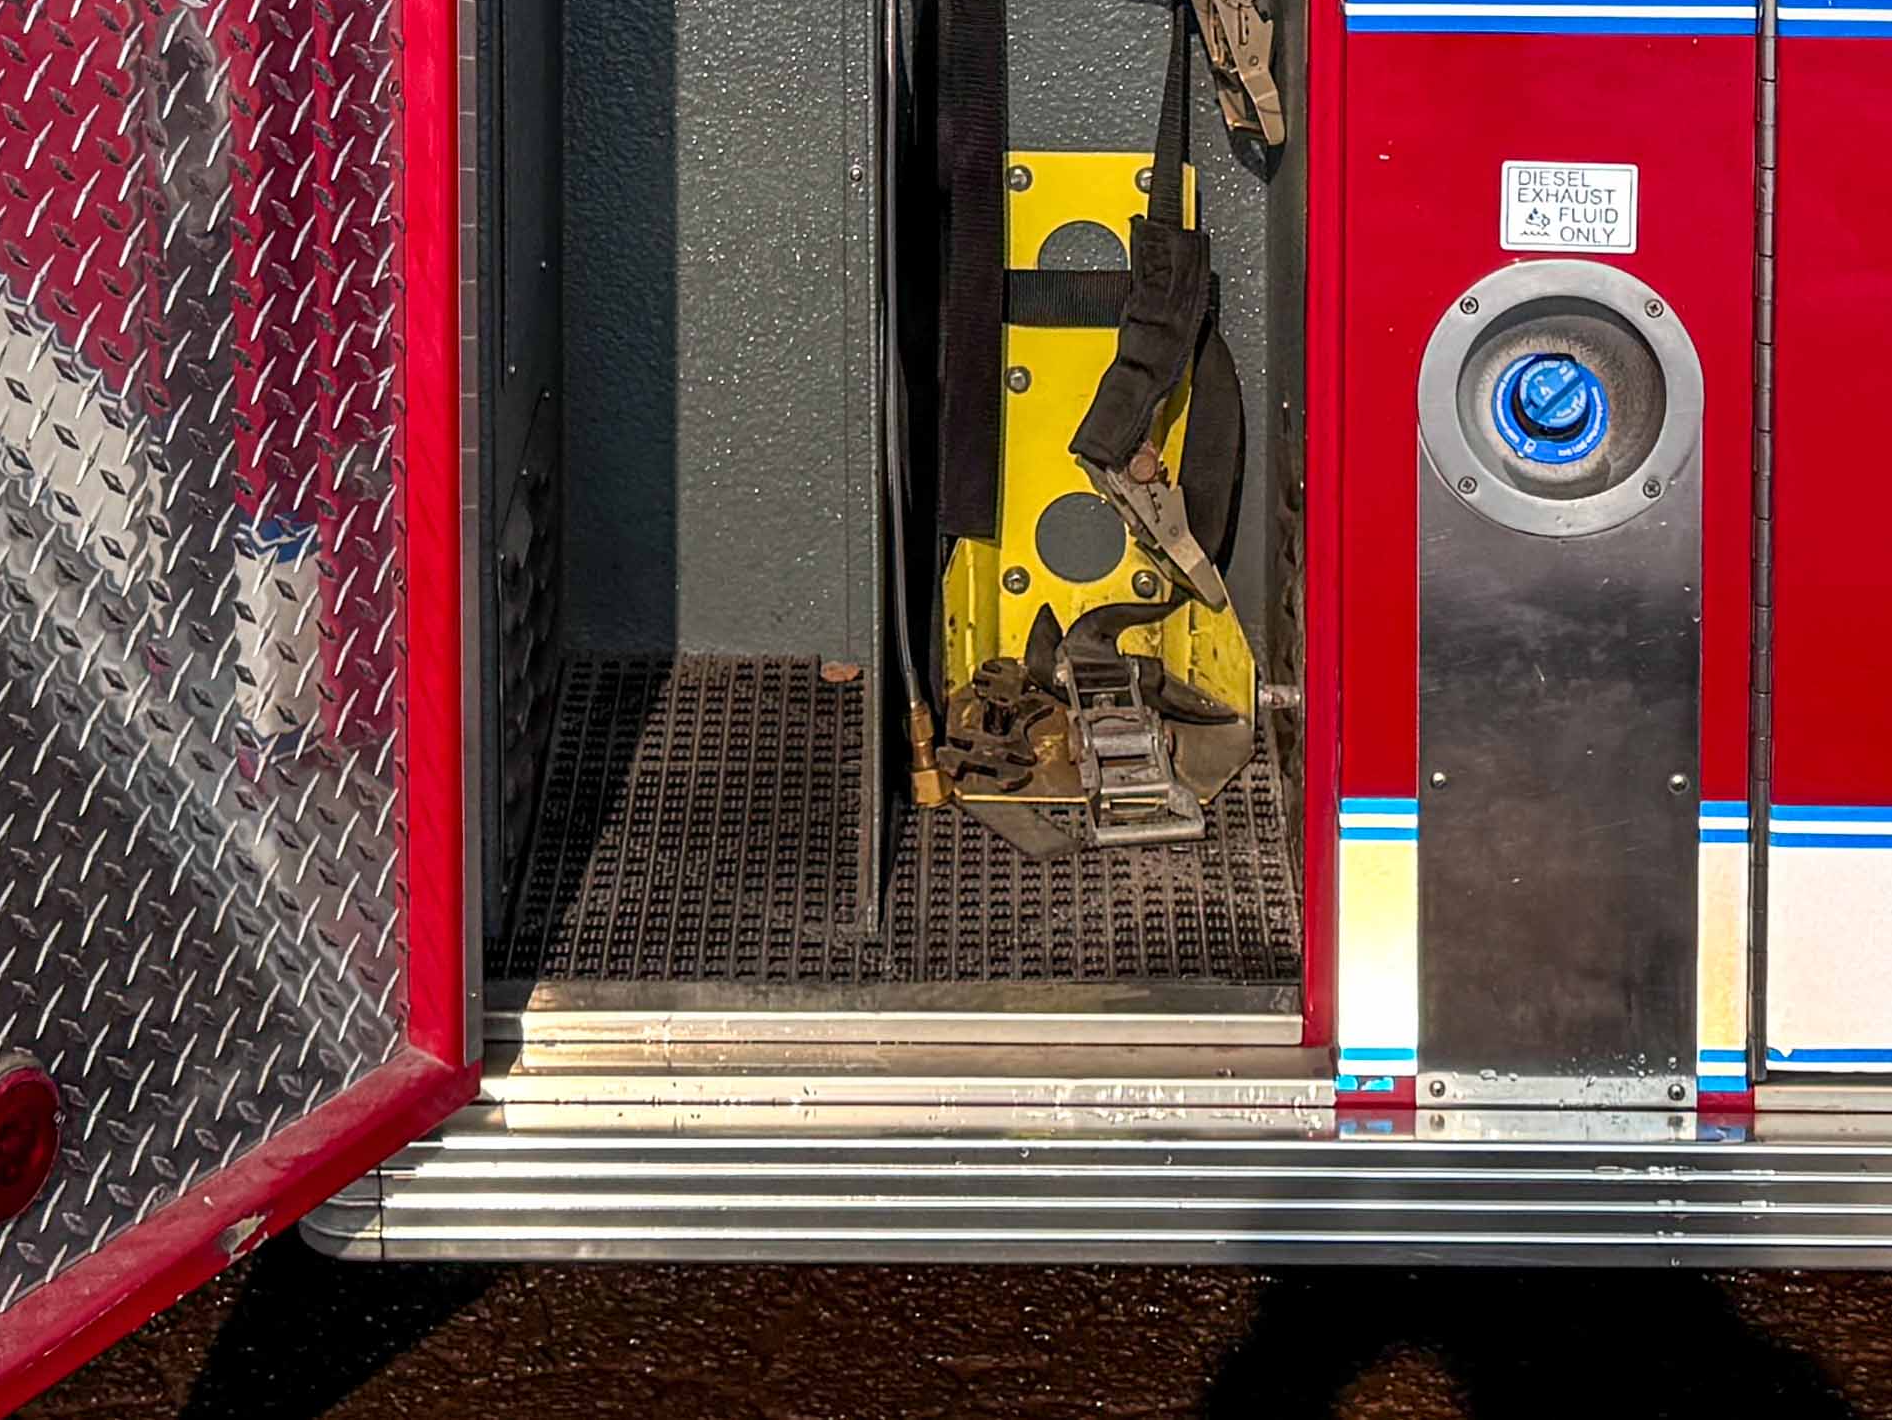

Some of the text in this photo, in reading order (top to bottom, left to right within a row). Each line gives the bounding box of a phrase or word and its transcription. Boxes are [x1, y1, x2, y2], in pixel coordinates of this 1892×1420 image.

[1517, 169, 1592, 187] DIESEL
[1517, 187, 1617, 205] EXHAUST
[1559, 206, 1619, 224] FLUID
[1559, 225, 1616, 246] ONLY
